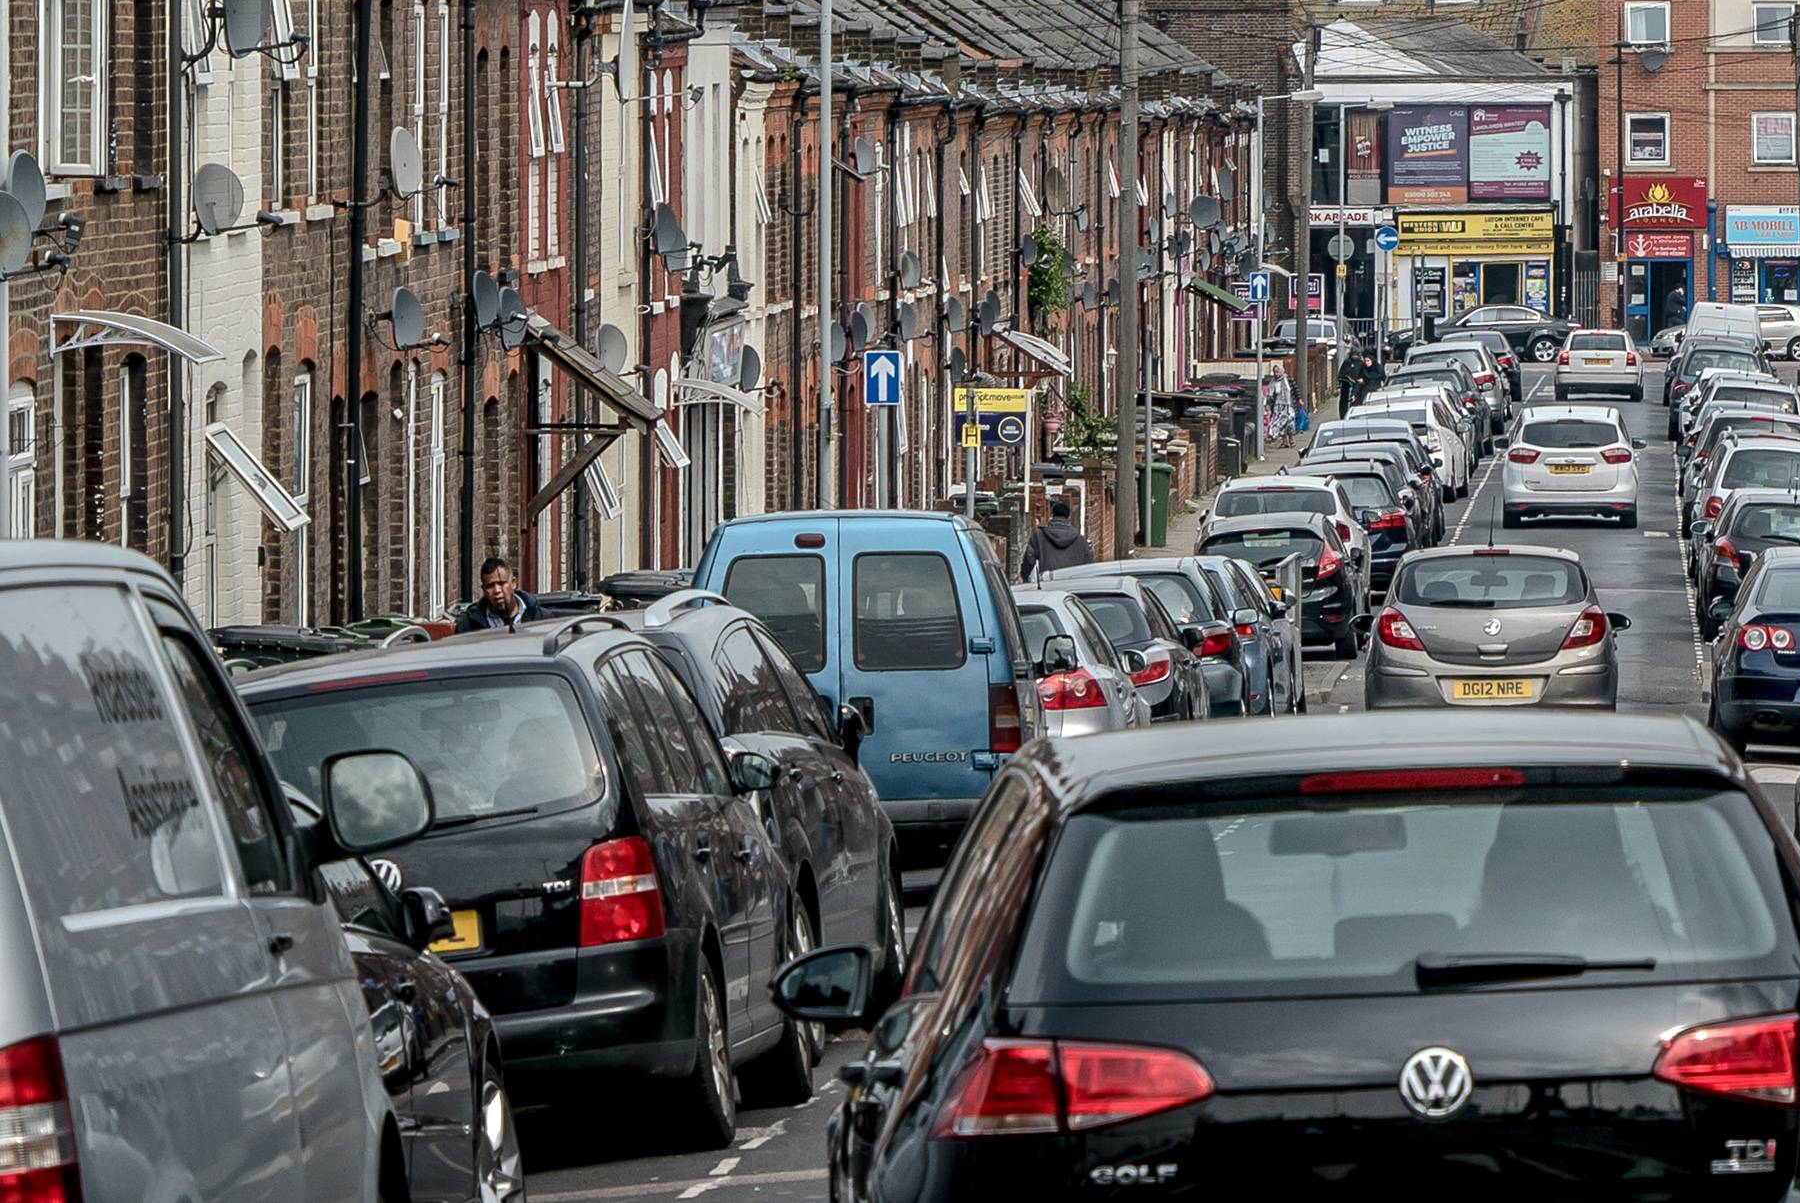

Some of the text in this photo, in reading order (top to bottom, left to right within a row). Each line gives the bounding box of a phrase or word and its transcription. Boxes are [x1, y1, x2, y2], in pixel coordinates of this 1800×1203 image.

[1405, 124, 1453, 136] WITNESS
[1401, 132, 1456, 145] EMPOWER
[1407, 141, 1450, 152] JUSTICE
[1324, 213, 1369, 221] ARADE
[1629, 203, 1687, 219] arabella
[1733, 221, 1795, 230] AB MOBILE
[965, 427, 978, 445] H
[1462, 681, 1524, 695] DG12 NRE
[890, 751, 969, 763] PEUGEOT
[541, 879, 573, 894] TDI
[1724, 1139, 1777, 1160] TDI
[1089, 1163, 1178, 1186] GOLF
